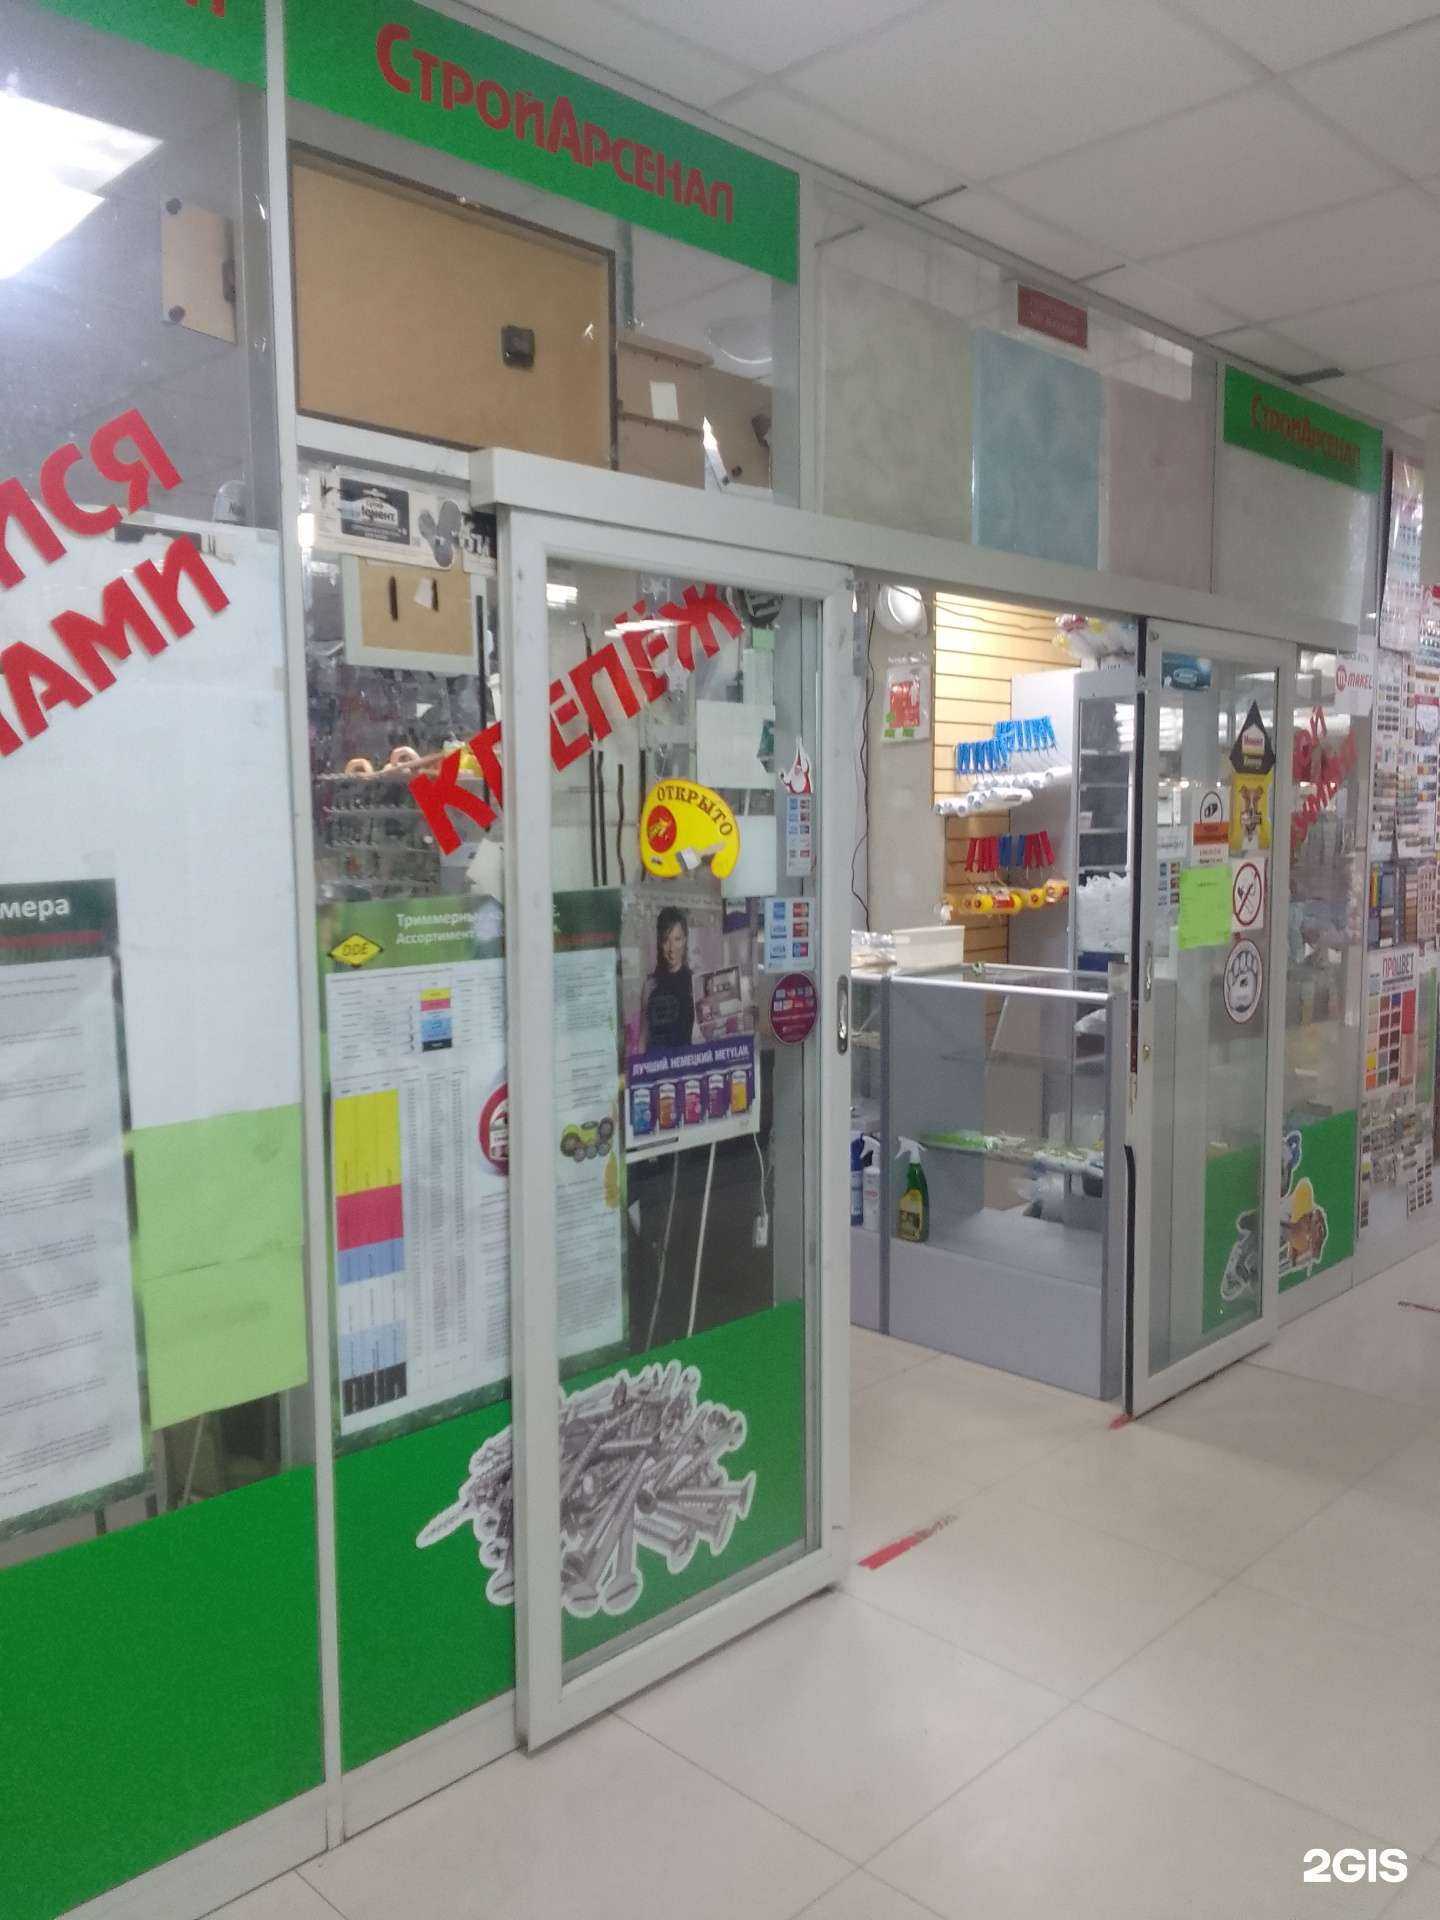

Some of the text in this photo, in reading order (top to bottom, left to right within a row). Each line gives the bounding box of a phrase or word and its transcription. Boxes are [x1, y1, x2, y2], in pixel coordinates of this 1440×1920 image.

[0, 533, 231, 757] АМИ
[657, 785, 733, 836] ОТКРЫТО
[670, 1050, 714, 1069] НЕМЕЦКИЙ
